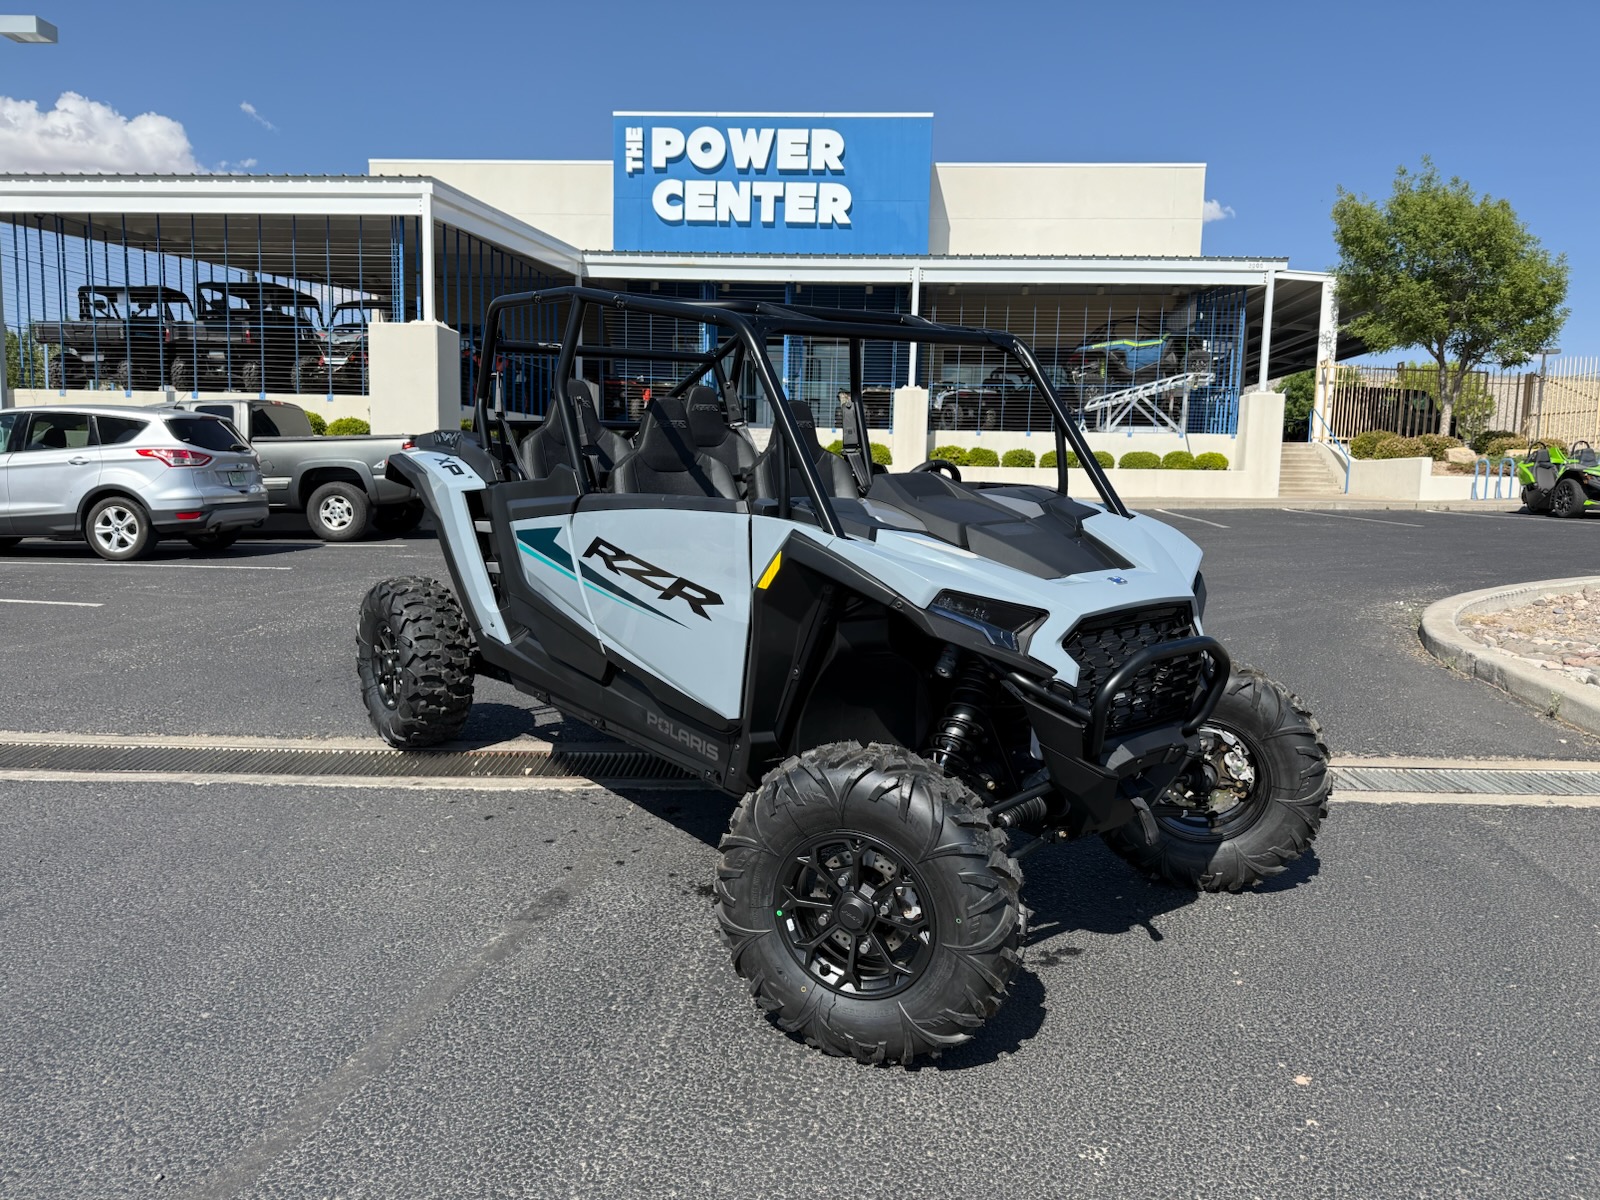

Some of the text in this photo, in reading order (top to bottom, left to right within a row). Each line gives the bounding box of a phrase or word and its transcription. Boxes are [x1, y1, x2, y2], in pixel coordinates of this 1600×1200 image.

[626, 127, 643, 173] THE
[652, 126, 845, 172] POWER
[652, 179, 852, 225] CENTER
[433, 457, 465, 476] XP
[582, 536, 724, 622] RZR
[646, 711, 719, 761] POLARIS
